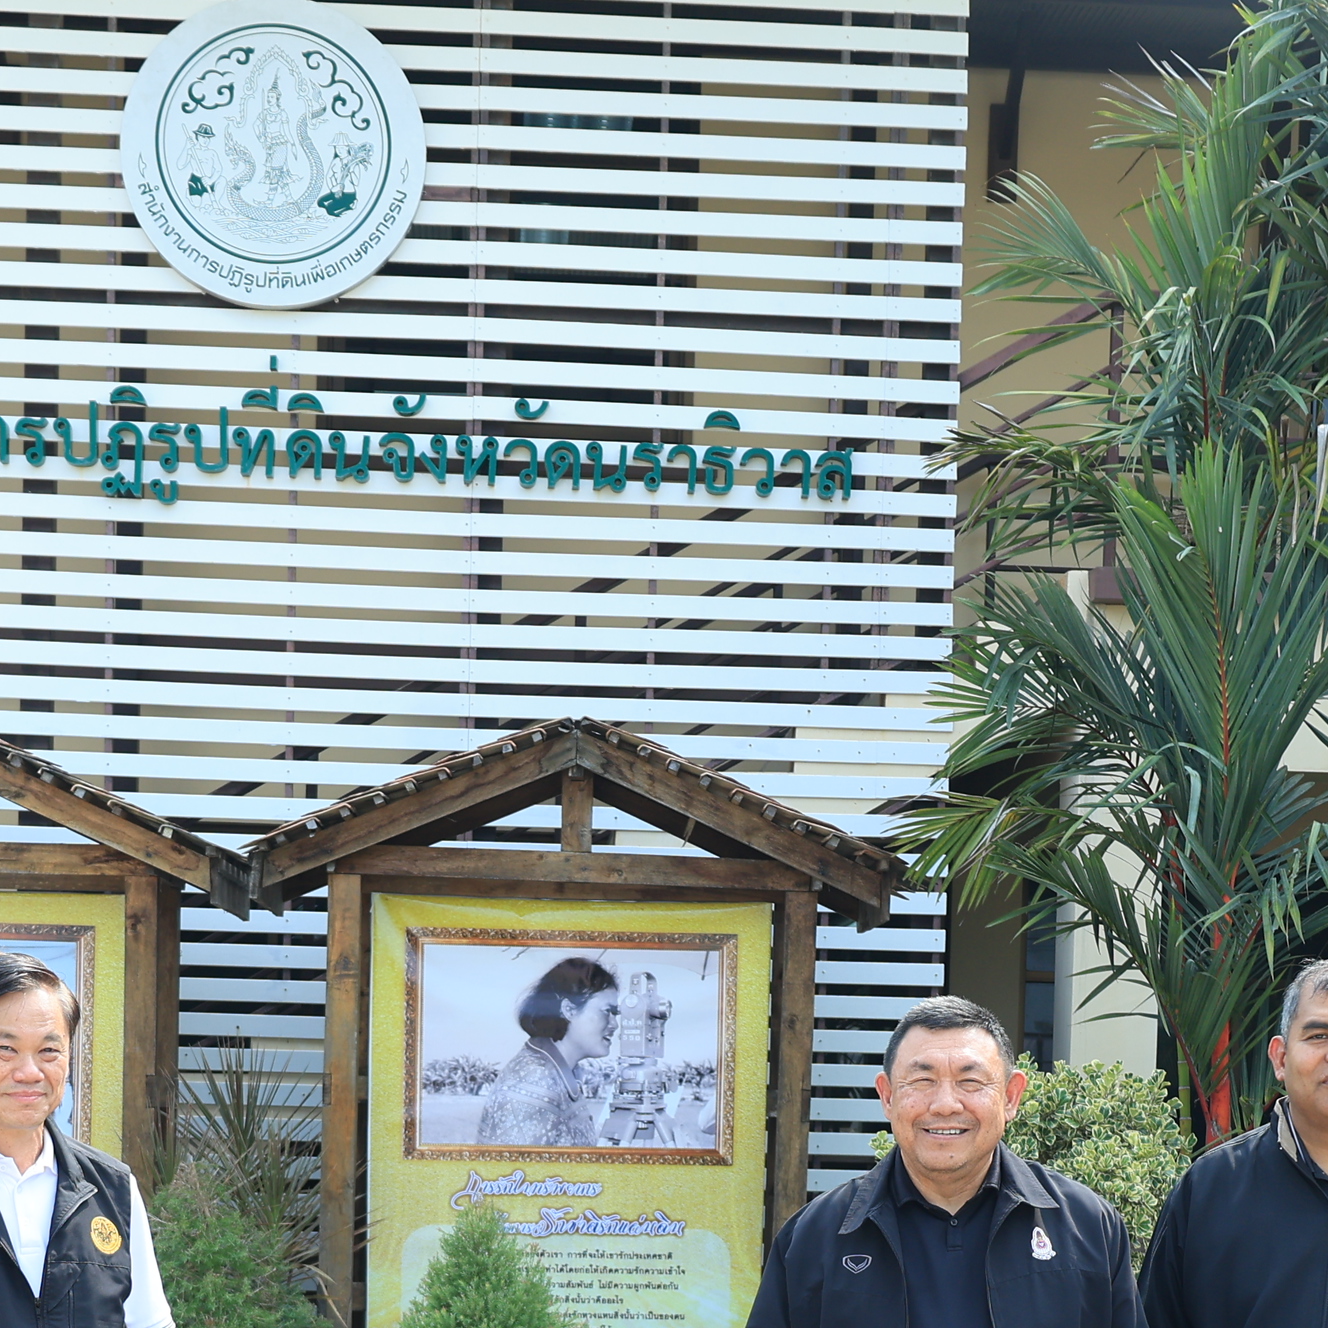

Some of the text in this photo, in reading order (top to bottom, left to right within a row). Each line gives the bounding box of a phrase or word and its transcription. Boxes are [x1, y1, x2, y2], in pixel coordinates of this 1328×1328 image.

[137, 181, 408, 294] สำนักงานการปฏิรูปที่ดินเพื่อเกษตรกรรม
